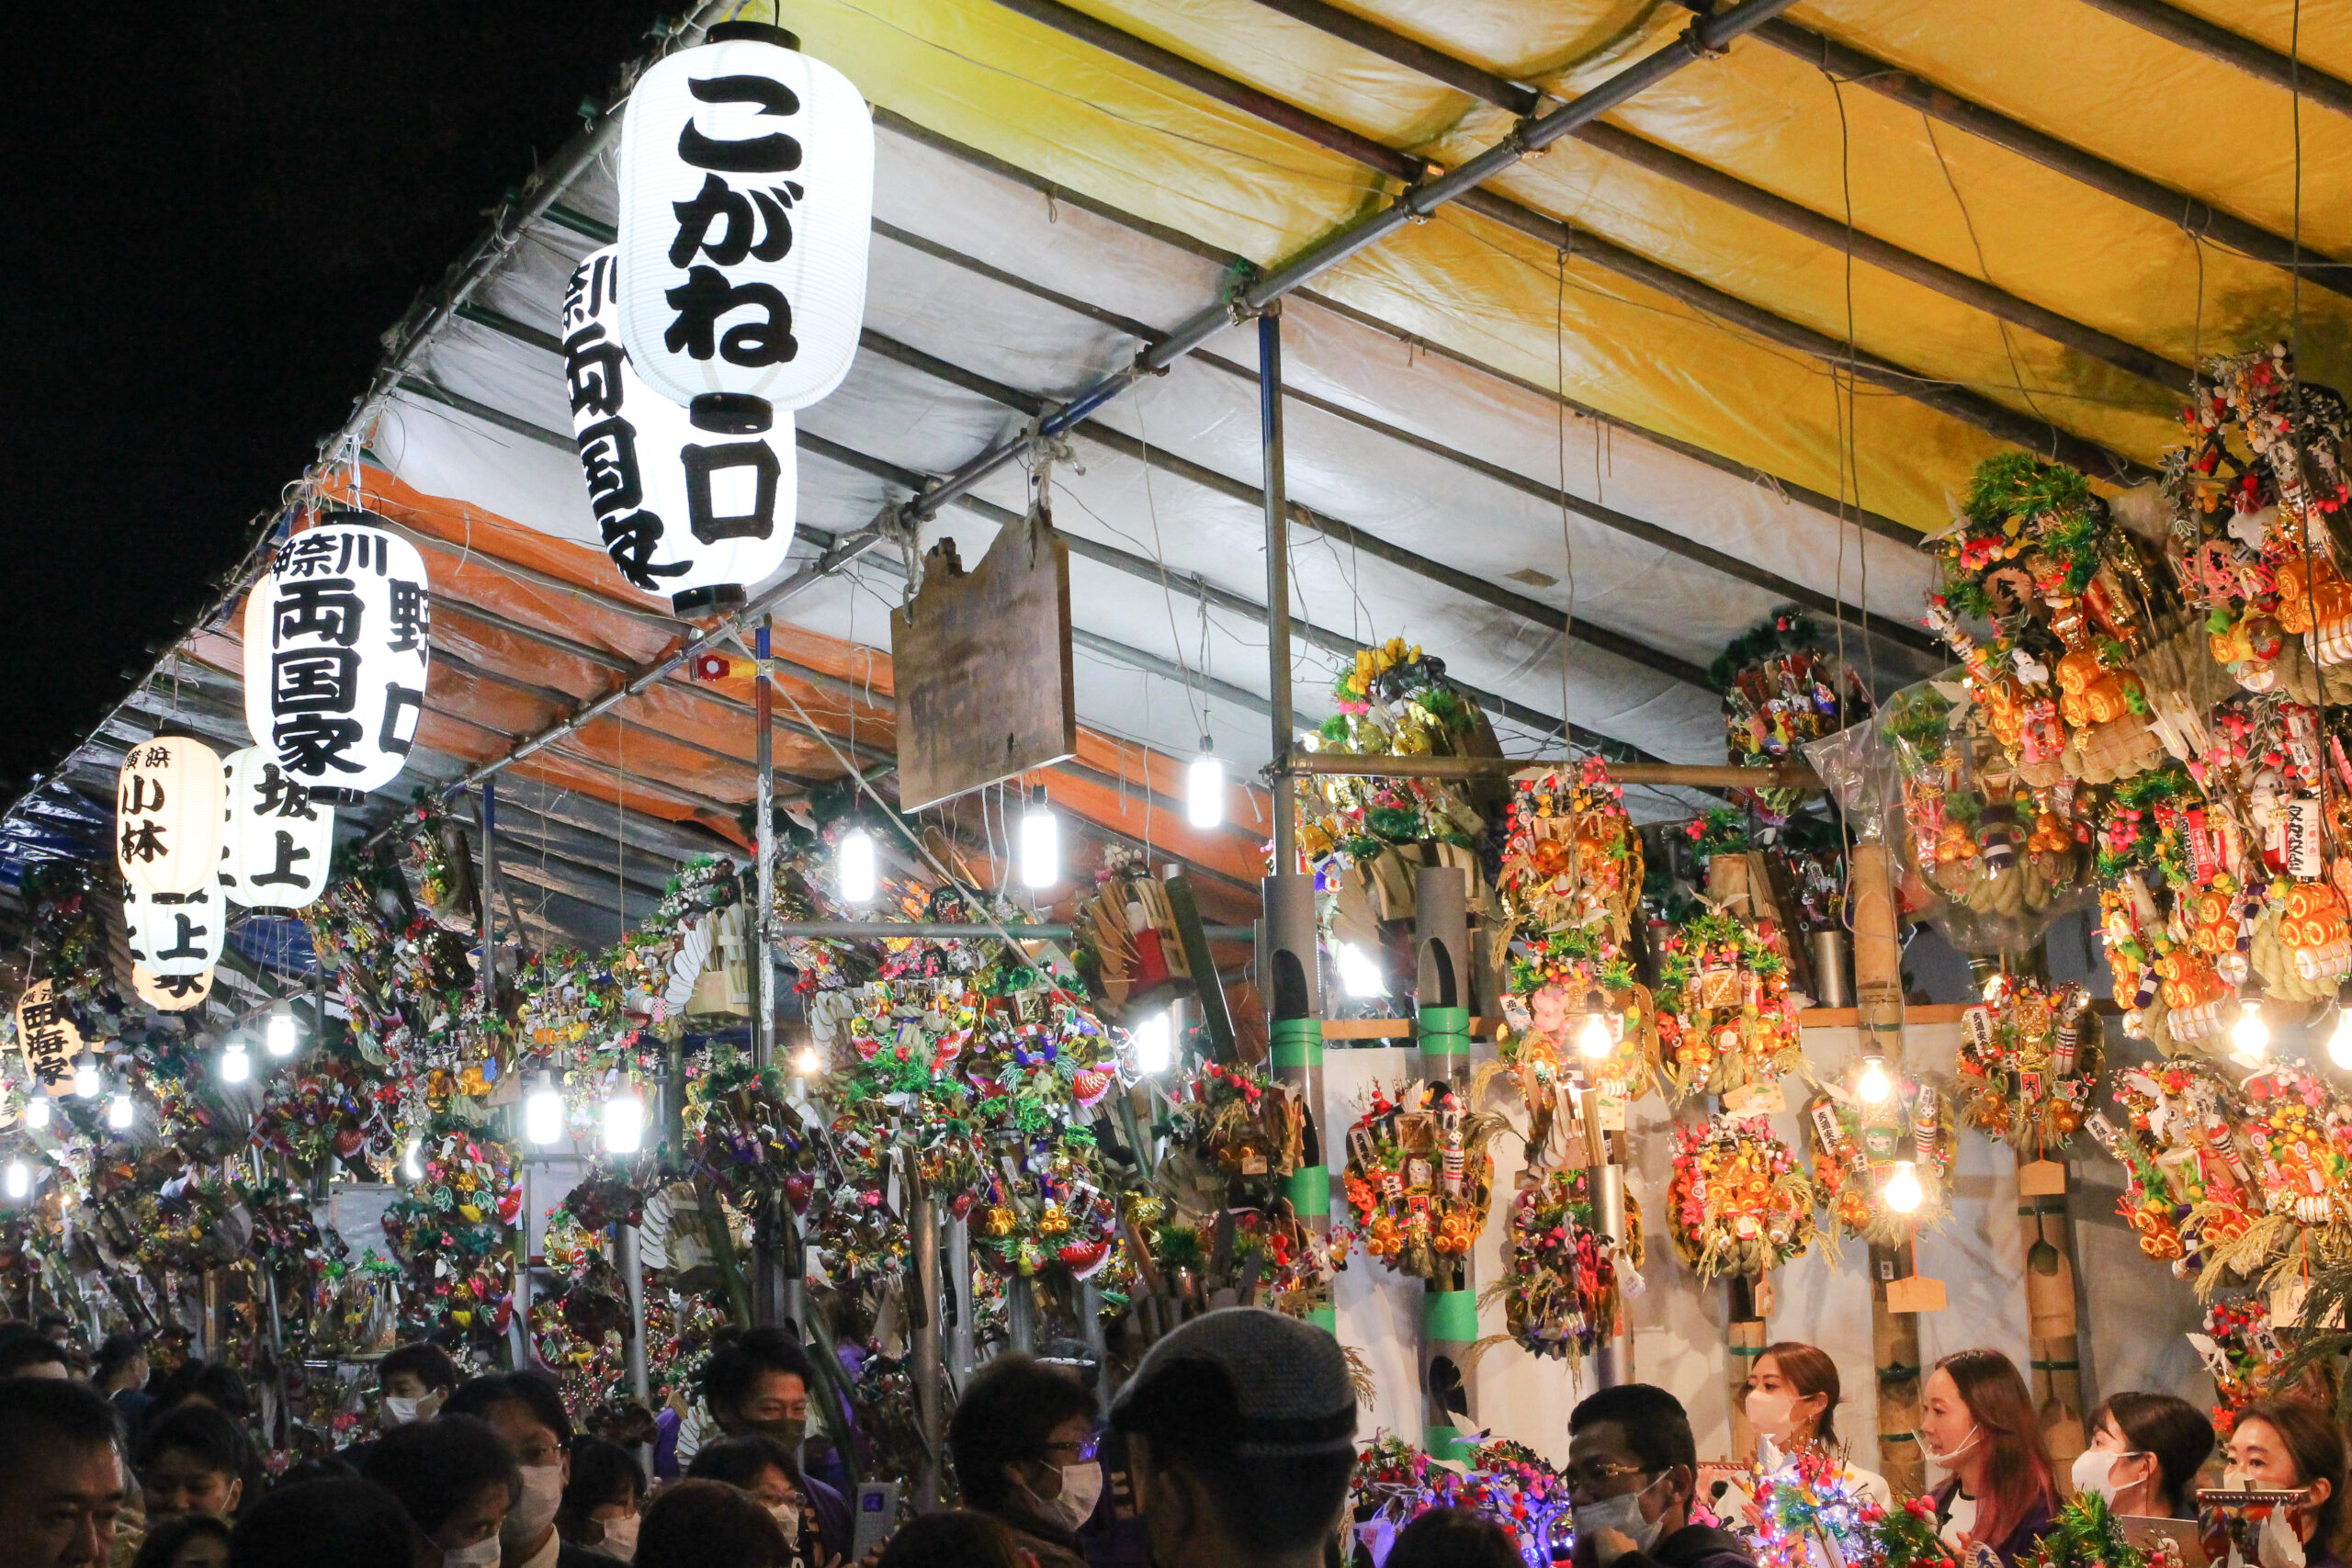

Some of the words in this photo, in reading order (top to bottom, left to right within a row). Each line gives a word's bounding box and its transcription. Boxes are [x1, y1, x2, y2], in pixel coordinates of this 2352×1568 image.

[664, 75, 804, 367] こがね
[269, 533, 389, 581] 神奈川
[272, 578, 367, 776] 両国家
[379, 577, 431, 761] 野口
[121, 774, 169, 864] 小林
[250, 763, 318, 889] 坂上
